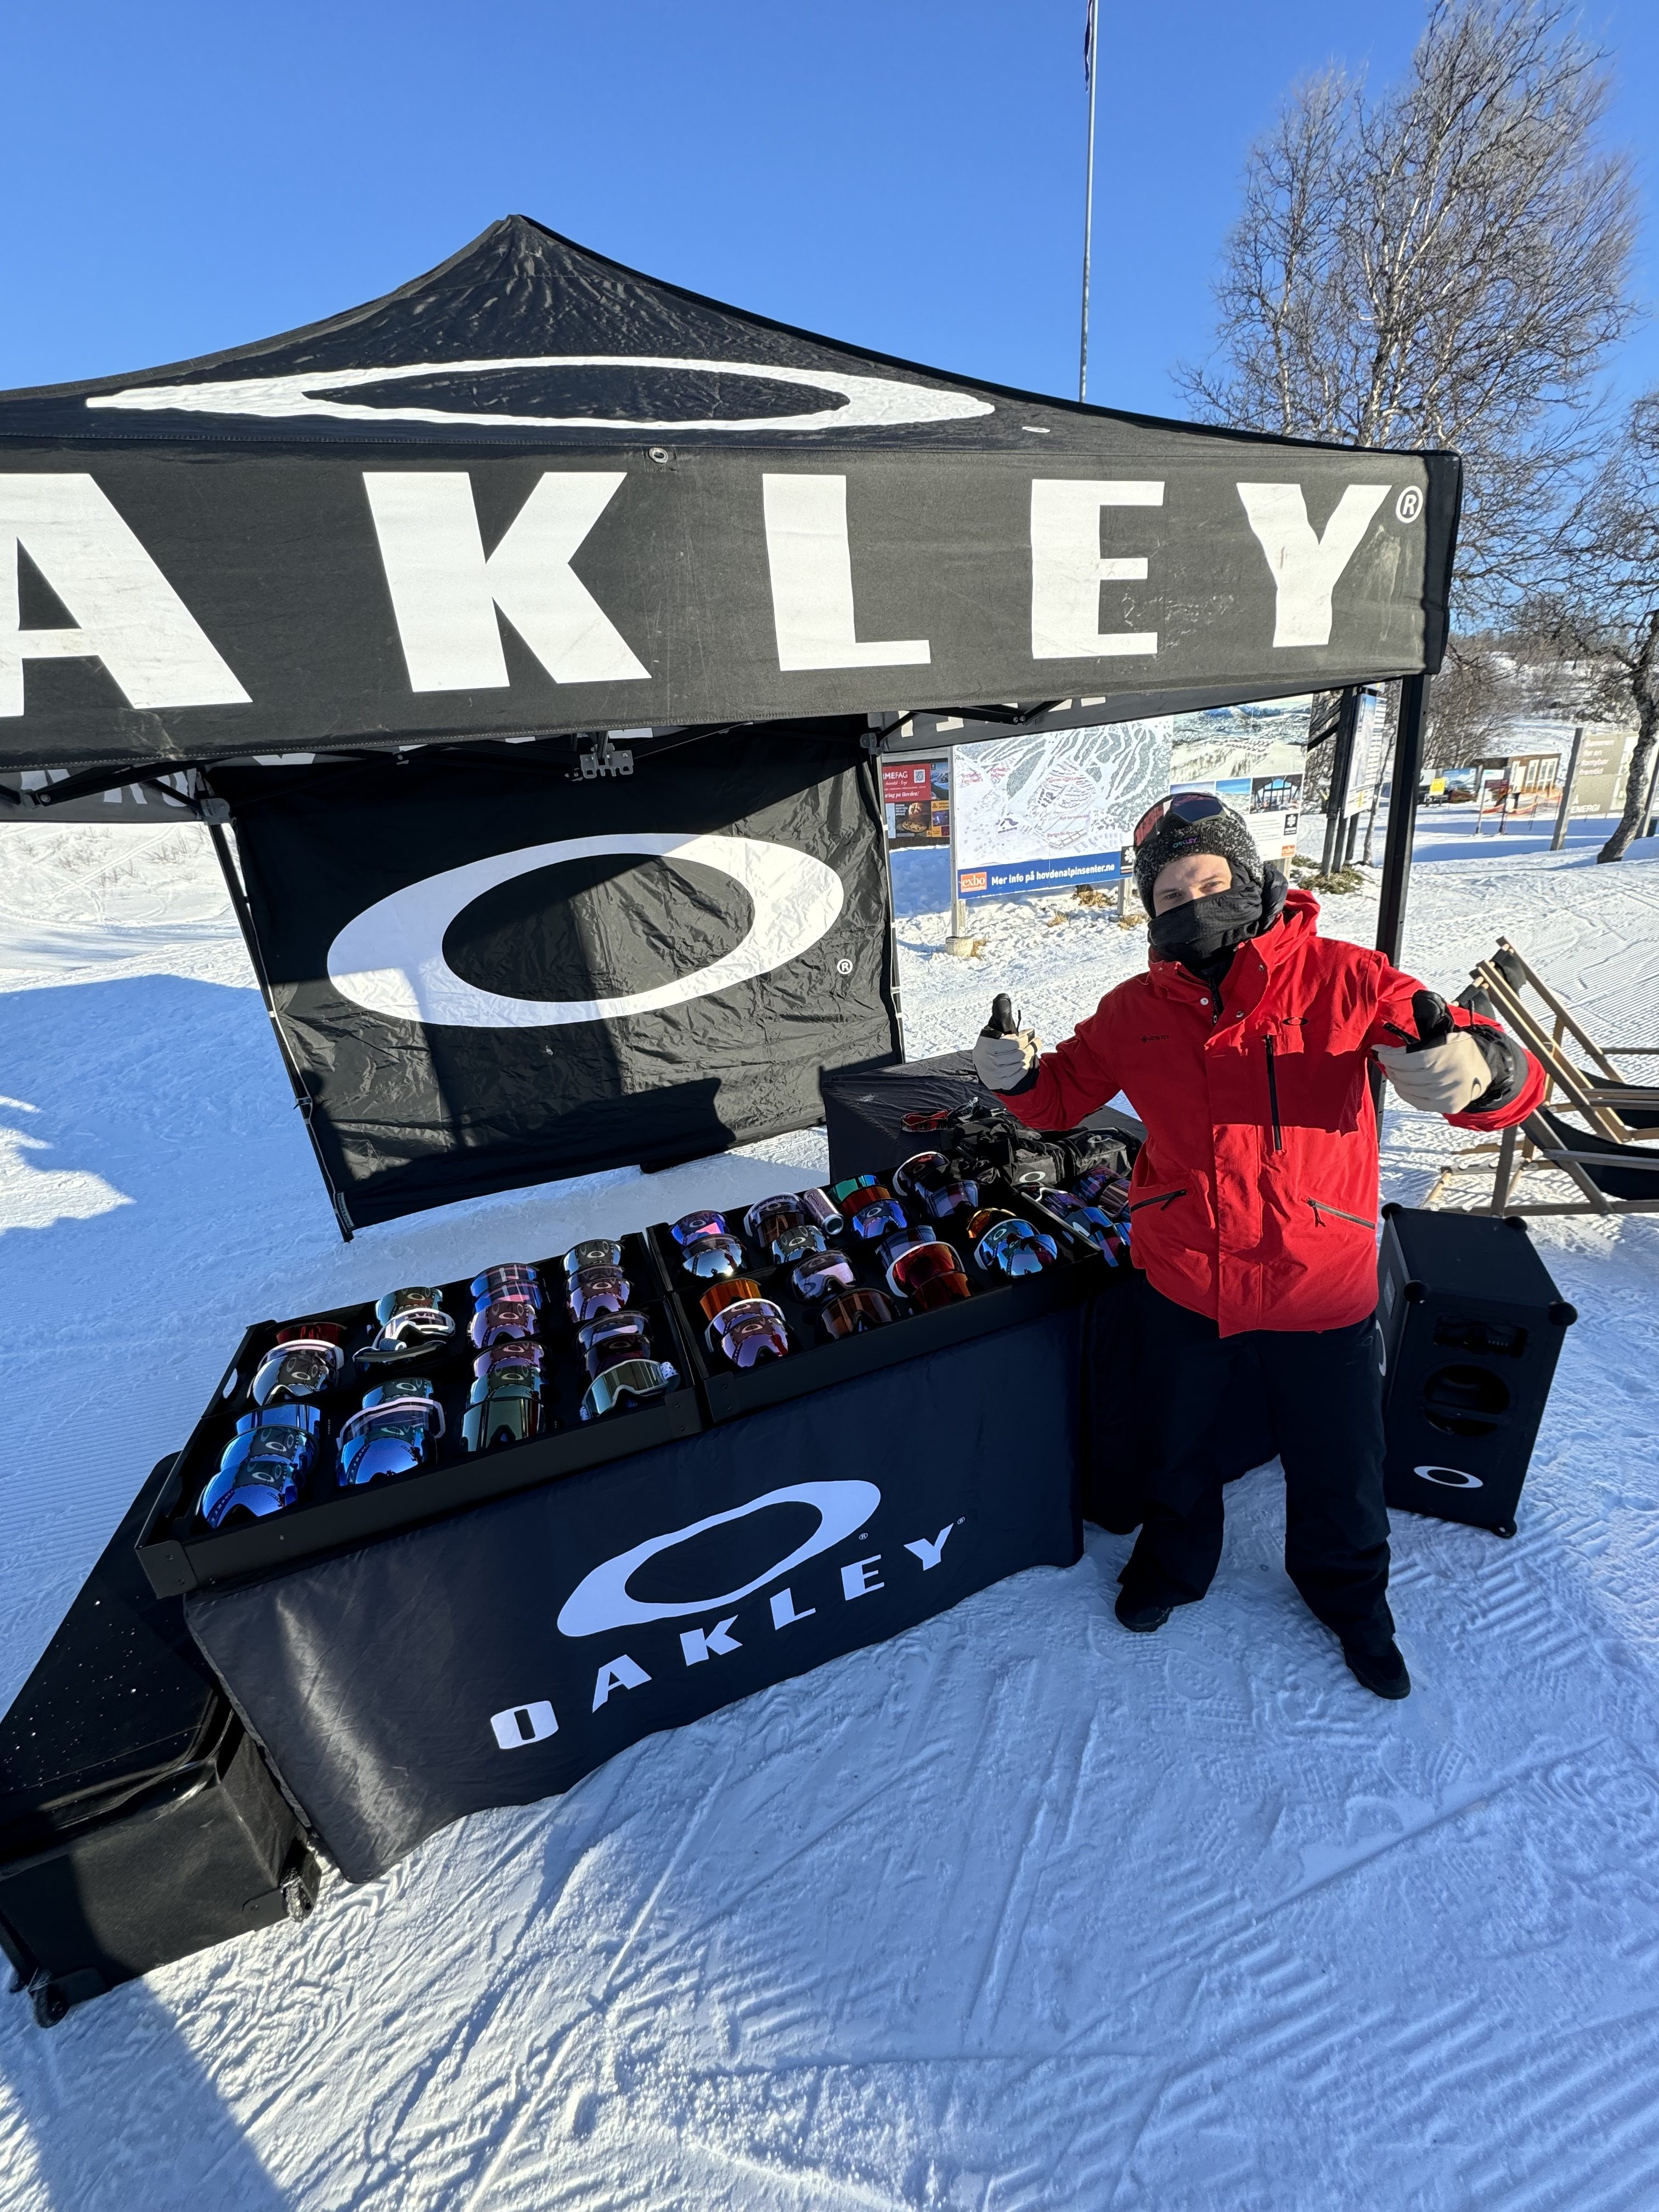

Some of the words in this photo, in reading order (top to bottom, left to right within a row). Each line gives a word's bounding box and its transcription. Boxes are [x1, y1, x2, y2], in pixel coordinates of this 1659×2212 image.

[1570, 804, 1600, 813] ENERGI
[962, 874, 985, 887] exbo
[991, 876, 1007, 886] Mer
[1009, 873, 1024, 883] info
[1025, 871, 1035, 883] på
[1036, 864, 1115, 879] hovdenalpinsenter.no
